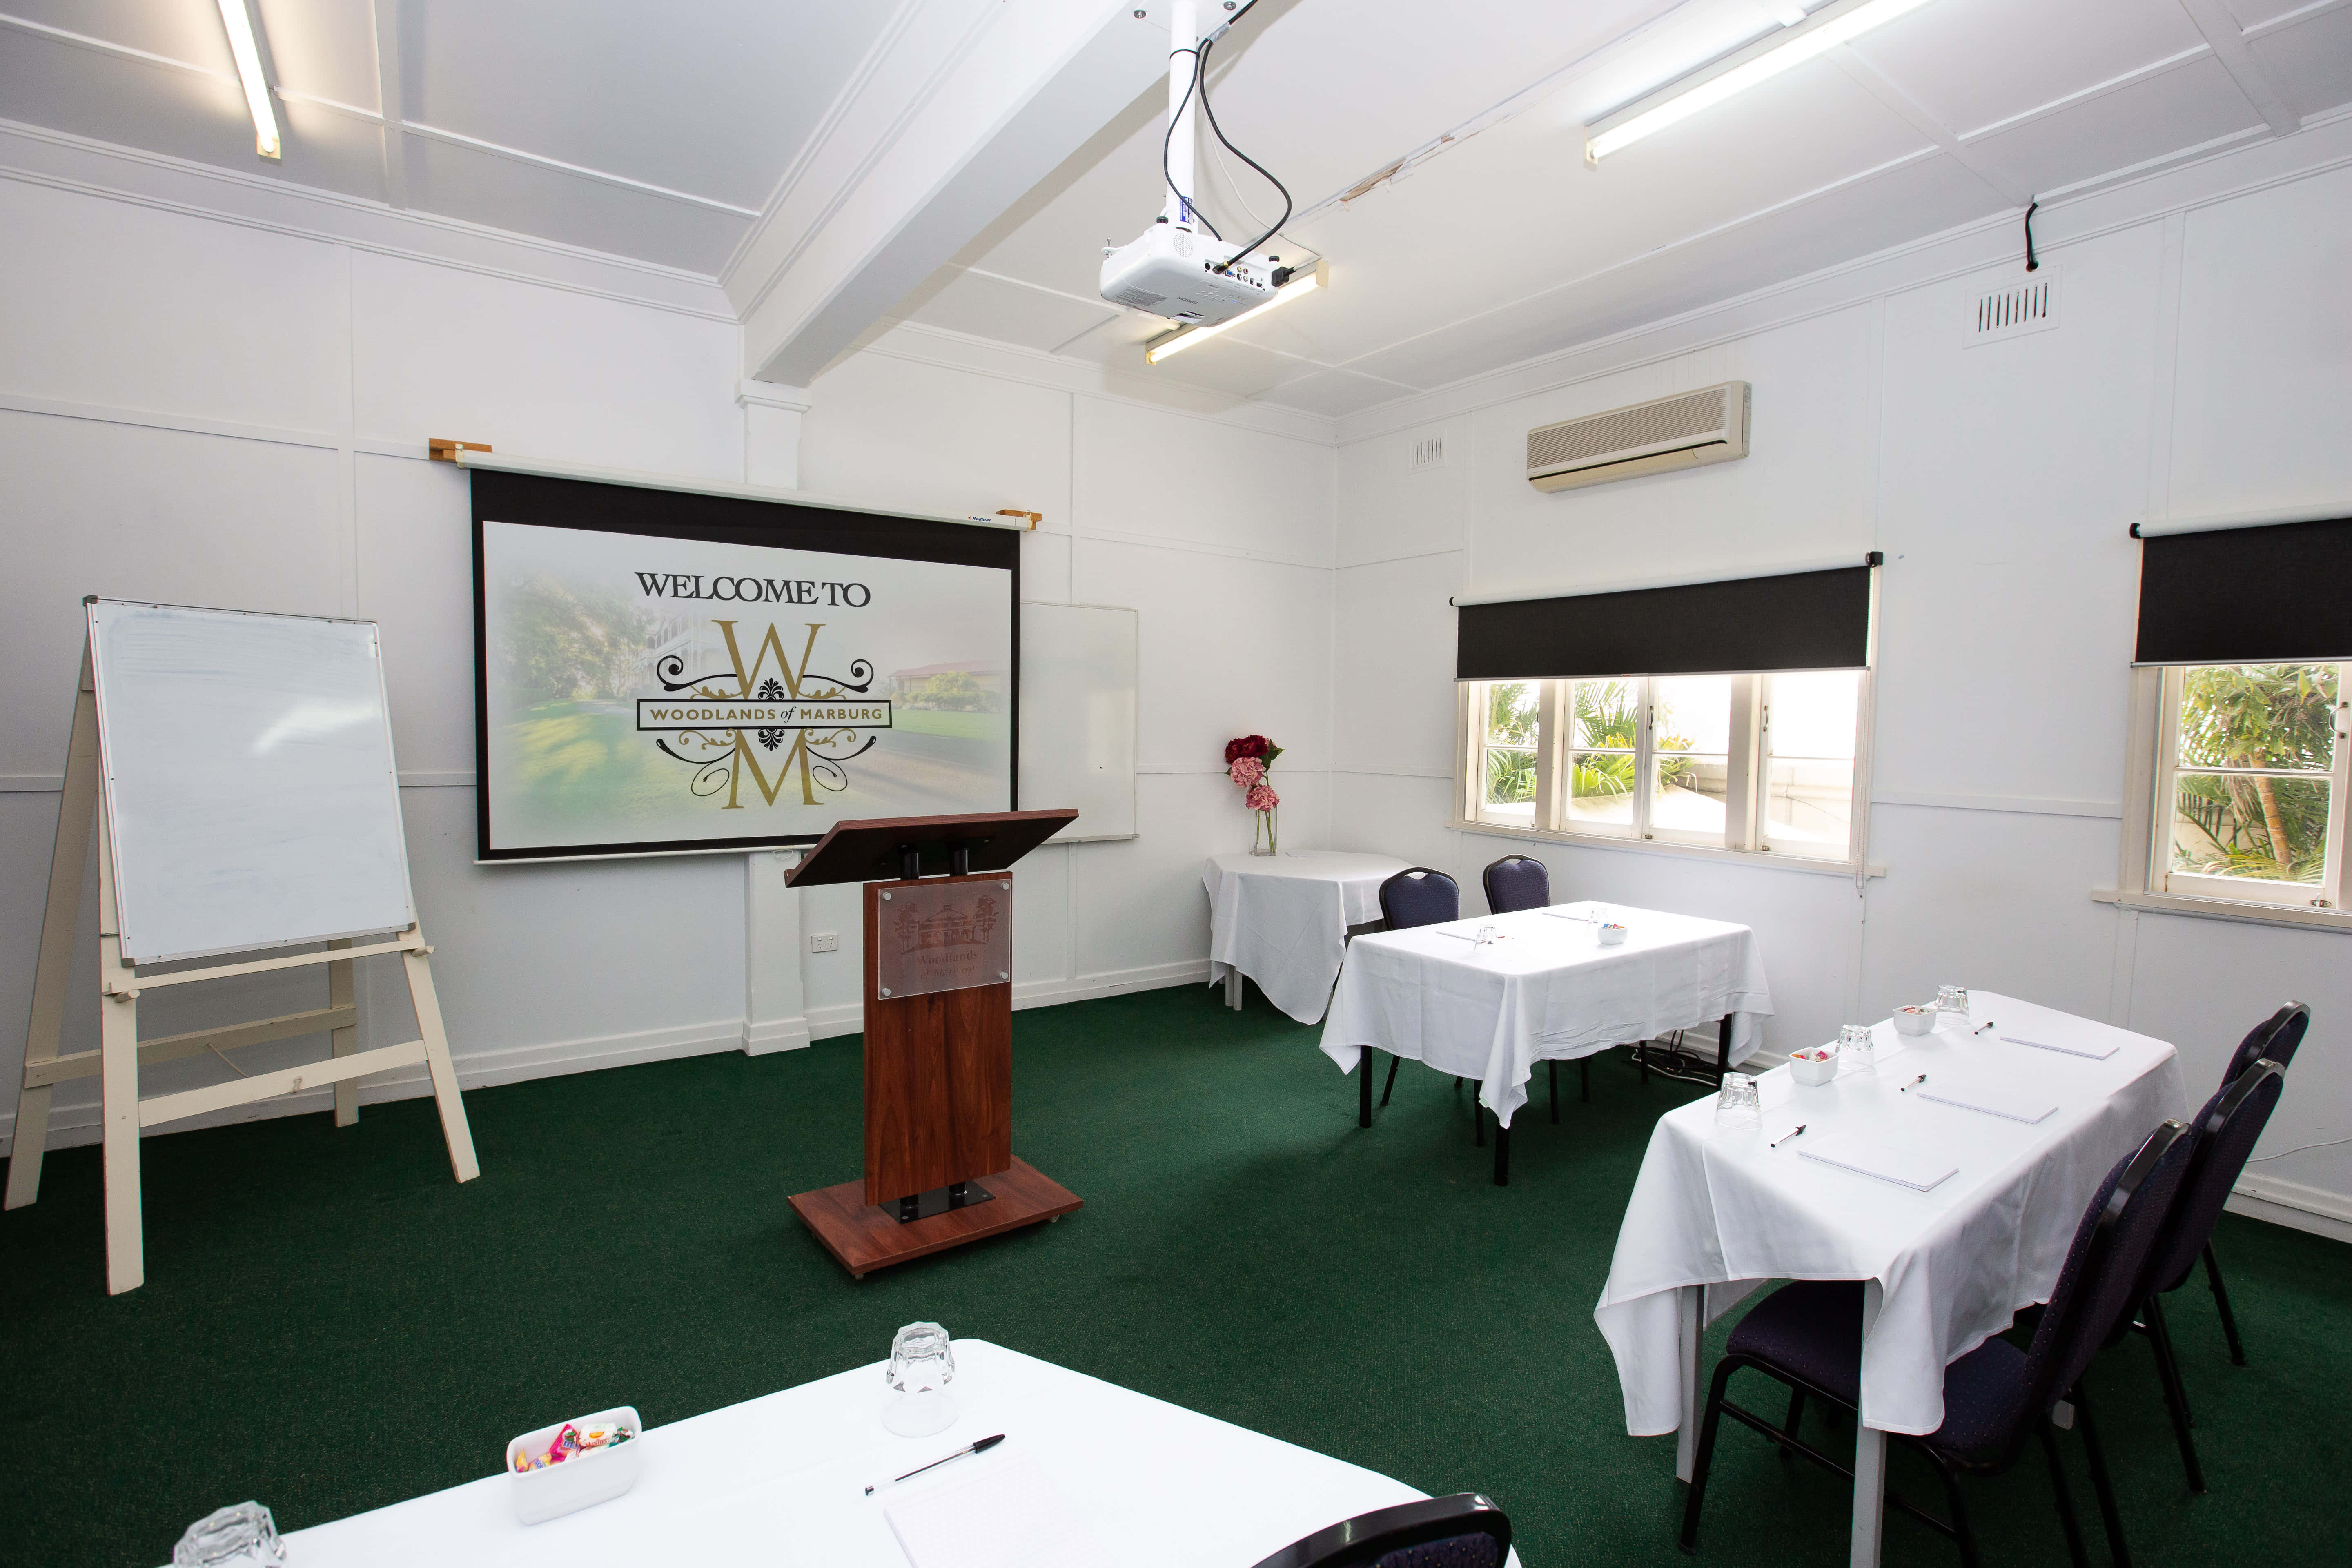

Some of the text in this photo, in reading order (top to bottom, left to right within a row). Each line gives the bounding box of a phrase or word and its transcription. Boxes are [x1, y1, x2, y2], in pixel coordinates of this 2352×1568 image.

[635, 572, 871, 607] WELCOME TO
[711, 620, 826, 700] W
[650, 706, 882, 723] WOODLANDS of MARBURG
[721, 728, 825, 810] M
[917, 949, 978, 965] Woodlands
